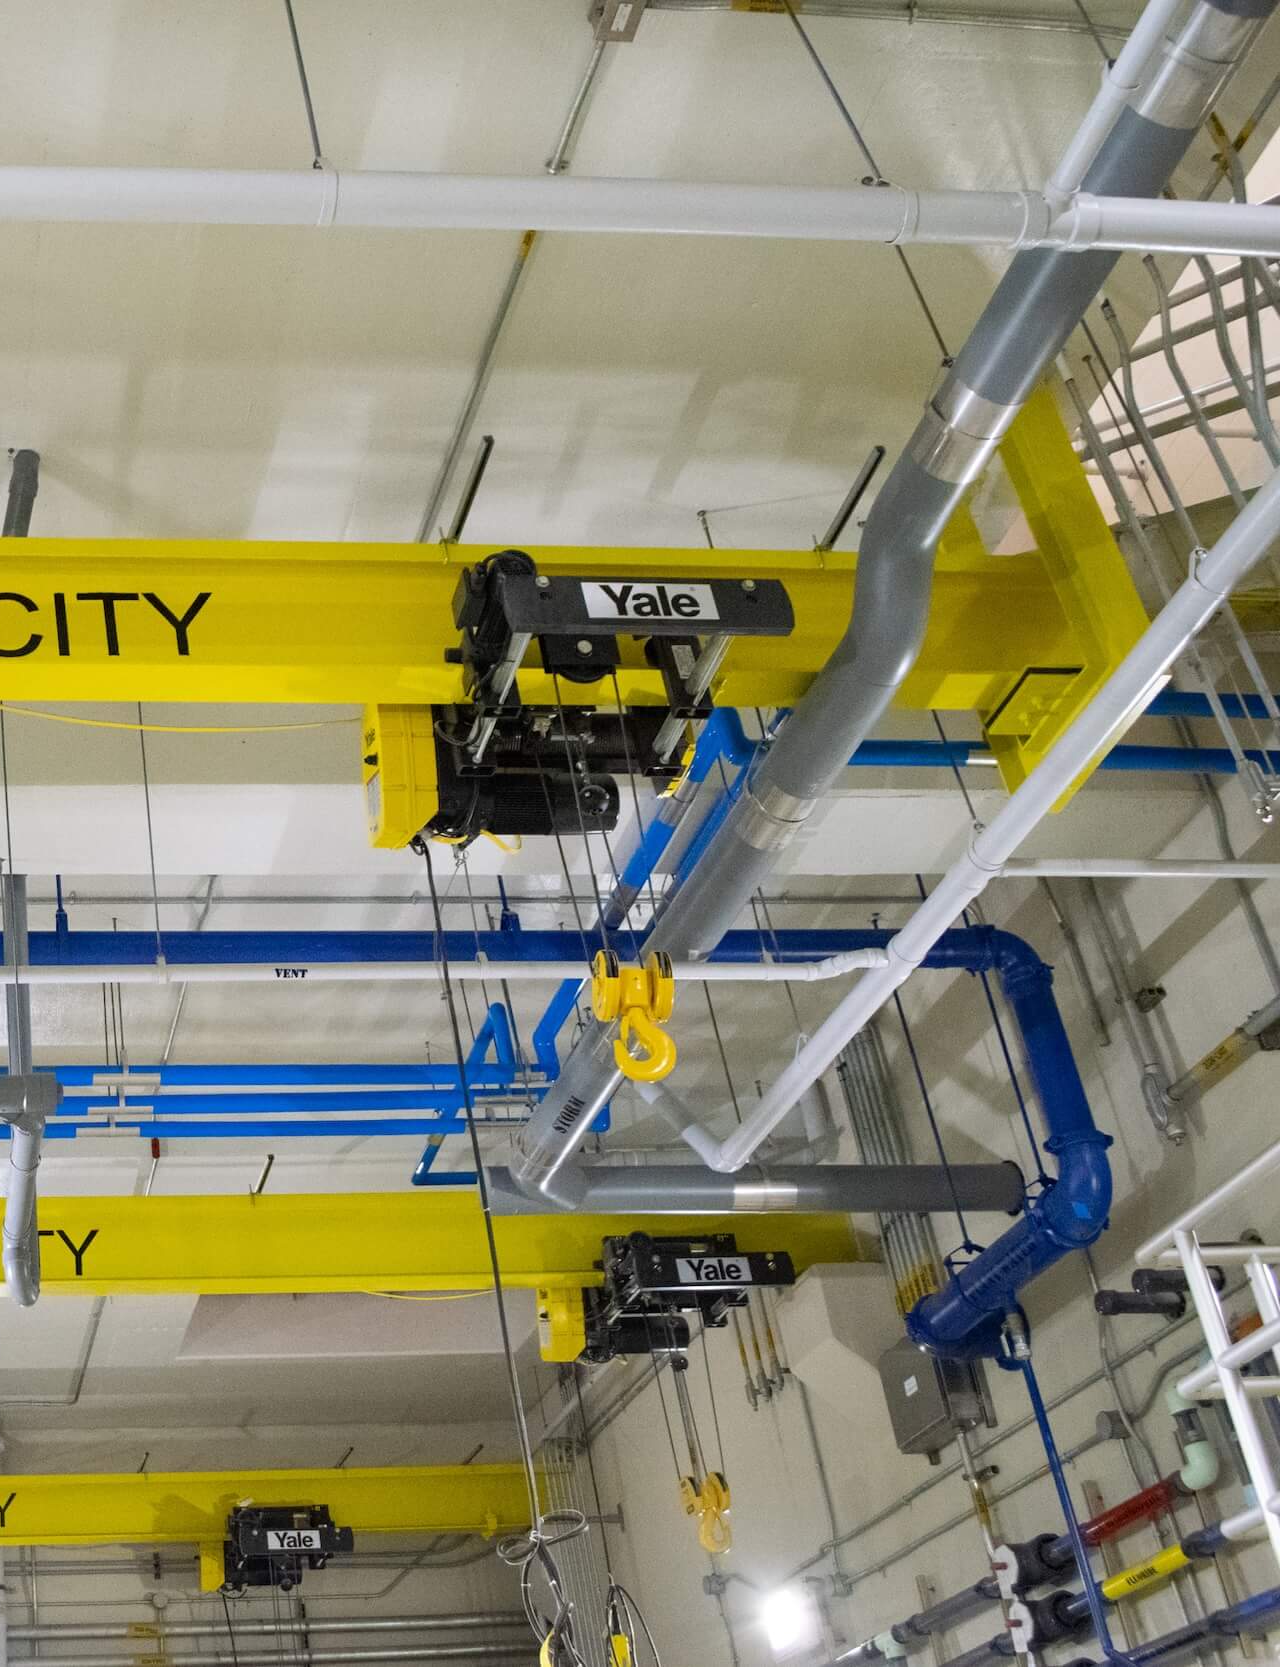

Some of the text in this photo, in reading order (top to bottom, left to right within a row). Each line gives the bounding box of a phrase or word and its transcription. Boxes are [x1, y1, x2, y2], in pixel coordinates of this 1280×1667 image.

[599, 584, 700, 617] Yale
[275, 967, 308, 979] VENT
[552, 1095, 585, 1134] STORM
[686, 1258, 741, 1281] Yale
[274, 1531, 313, 1548] Yale
